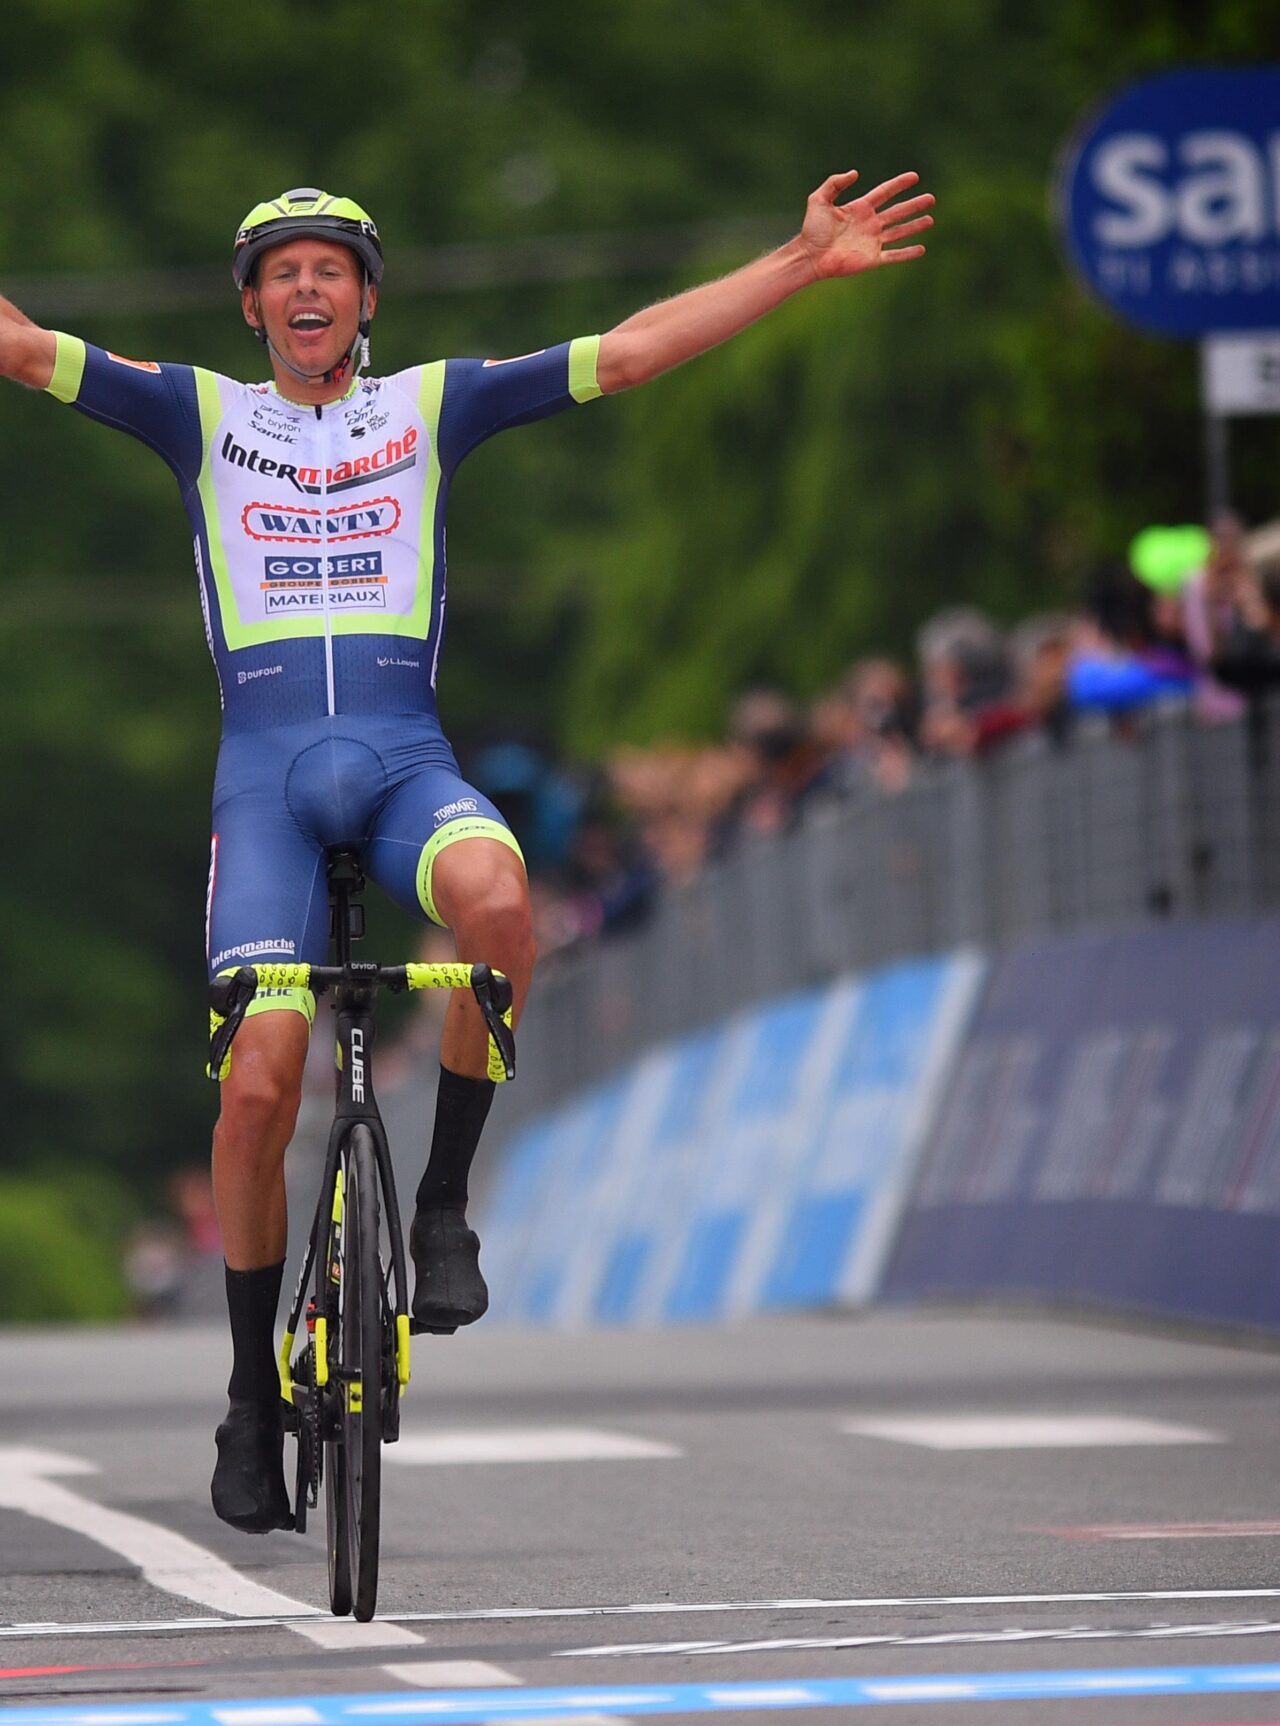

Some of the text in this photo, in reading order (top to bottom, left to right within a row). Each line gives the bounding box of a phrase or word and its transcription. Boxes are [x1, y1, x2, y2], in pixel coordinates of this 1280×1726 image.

[1090, 128, 1280, 250] sa
[247, 420, 299, 445] Santic
[260, 507, 384, 535] WANTY
[269, 556, 379, 575] GOBERT
[269, 580, 322, 588] GROUPE
[269, 590, 381, 607] MATERIAUX
[247, 665, 283, 680] DUFOUR
[433, 800, 478, 822] TORMANS
[350, 1027, 366, 1105] CUBE
